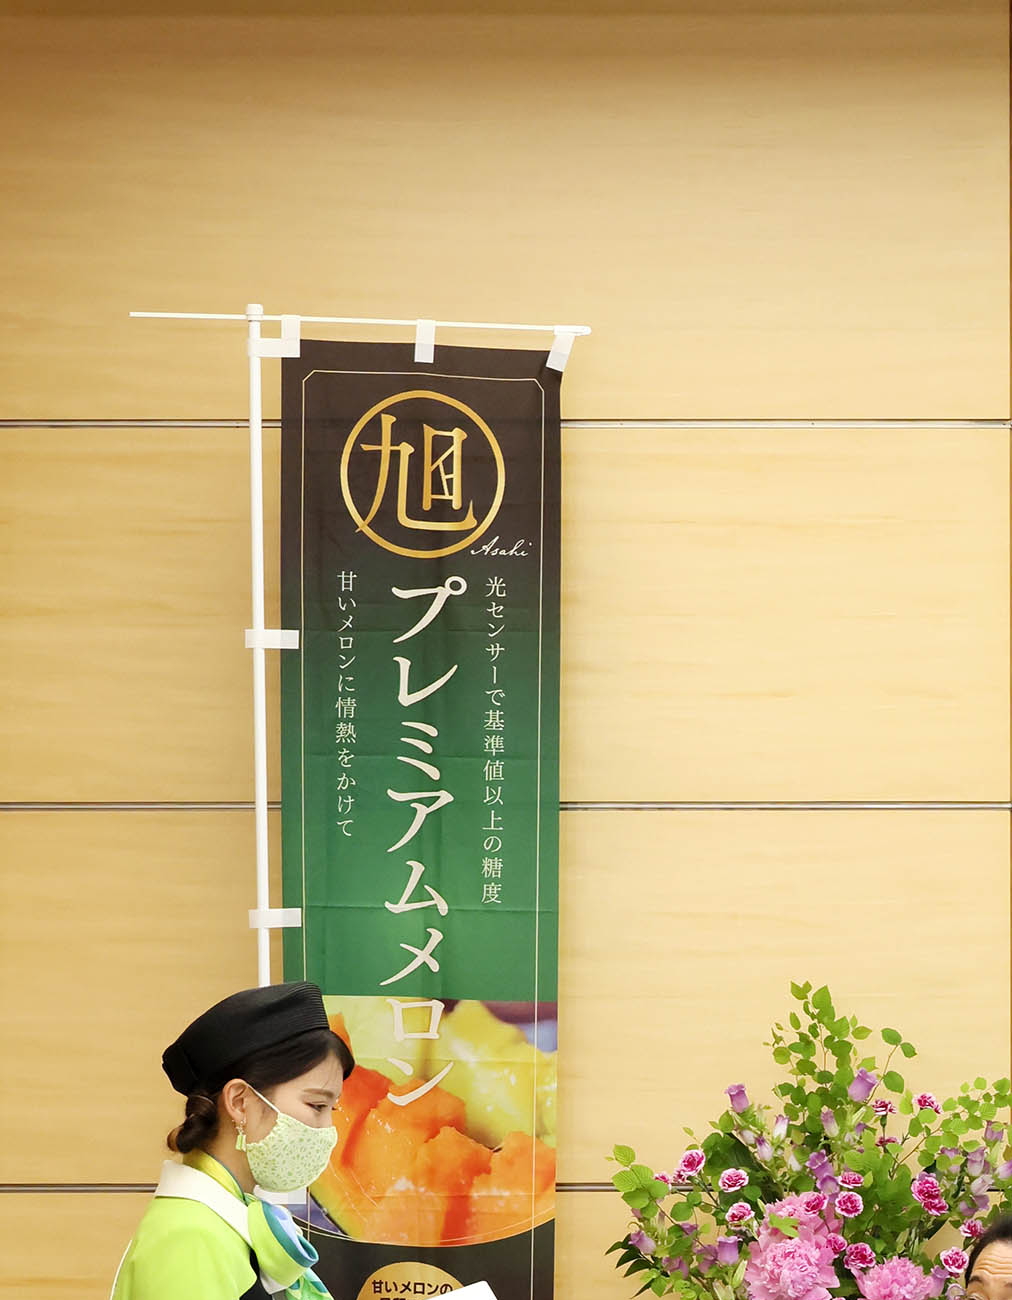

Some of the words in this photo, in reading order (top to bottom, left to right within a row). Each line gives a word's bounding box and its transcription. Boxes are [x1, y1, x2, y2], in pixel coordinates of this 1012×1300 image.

[471, 536, 533, 557] Asahi
[335, 570, 358, 837] 甘いメロンに情熱をかけて
[481, 576, 507, 904] 光センサーで基準値以上の糖度
[379, 575, 468, 1106] プレミアムメロン
[372, 1279, 454, 1296] 甘いメロンの
